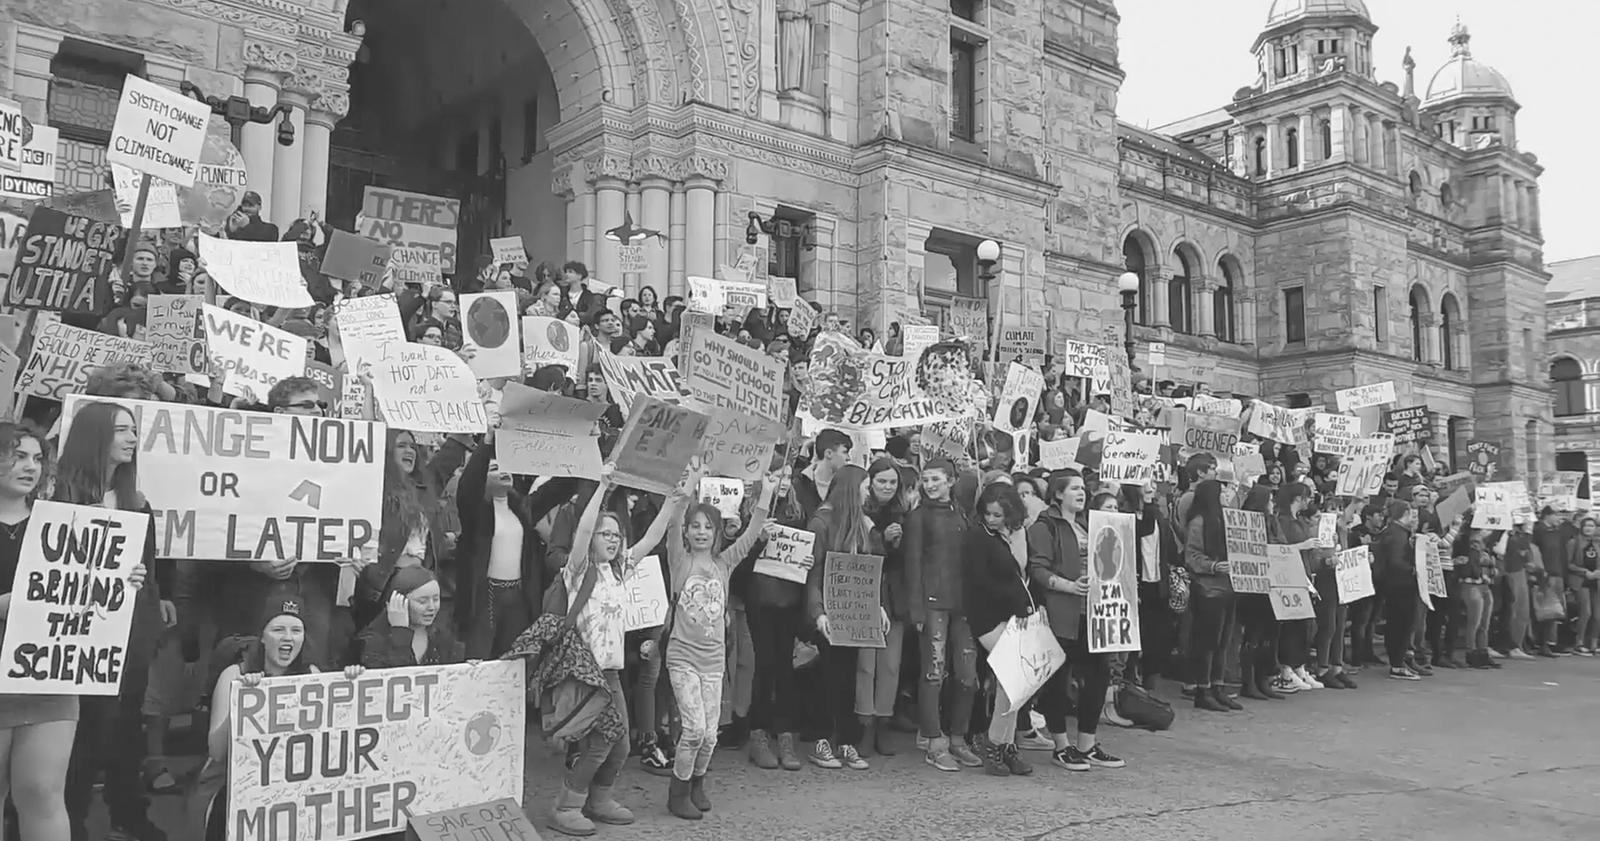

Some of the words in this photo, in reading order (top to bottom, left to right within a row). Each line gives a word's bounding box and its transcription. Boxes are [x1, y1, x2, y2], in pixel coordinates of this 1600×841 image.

[129, 90, 169, 117] SYSTEM
[169, 106, 204, 130] CHANGE
[145, 118, 178, 144] NOT
[115, 136, 164, 165] CLIMATE
[161, 151, 195, 175] CHANGE
[201, 167, 235, 185] PLANET
[370, 190, 459, 229] THERE'S
[64, 216, 89, 239] WE
[368, 221, 404, 241] NO
[21, 235, 87, 270] STAND
[391, 249, 440, 266] CHANGE
[8, 267, 77, 310] WITH
[73, 276, 96, 312] A
[398, 270, 436, 283] CLIMATE
[44, 323, 105, 347] CLIMATE
[208, 313, 293, 360] WE'RE
[1069, 341, 1085, 355] THE
[28, 352, 50, 373] IN
[37, 336, 81, 359] SHOULD
[83, 347, 101, 363] BE
[401, 346, 428, 362] want
[704, 338, 726, 358] WHY
[727, 349, 760, 373] SHOULD
[763, 365, 777, 382] WE
[1069, 354, 1080, 364] TO
[389, 365, 418, 384] HOT
[428, 365, 460, 380] DATE
[694, 350, 712, 367] GO
[717, 358, 733, 377] TO
[735, 368, 778, 400] SCHOOL
[386, 399, 421, 422] HOT
[735, 383, 779, 418] LISTEN
[850, 400, 945, 426] BLEACHING
[134, 404, 273, 460] ANGE
[289, 416, 374, 464] NOW
[1185, 428, 1238, 455] GREENER
[200, 471, 240, 498] OR
[41, 518, 127, 571] UNITE
[225, 514, 373, 562] LATER
[776, 541, 796, 553] NOT
[27, 569, 125, 612] BEHIND
[1101, 583, 1122, 600] I'M
[1093, 602, 1129, 618] WITH
[47, 611, 95, 638] THE
[1091, 618, 1132, 650] HER
[8, 637, 123, 686] SCIENCE
[237, 674, 439, 737] RESPECT
[252, 727, 380, 787] YOUR
[235, 780, 417, 841] MOTHER
[426, 812, 474, 833] SAVE
[480, 803, 512, 822] OUR
